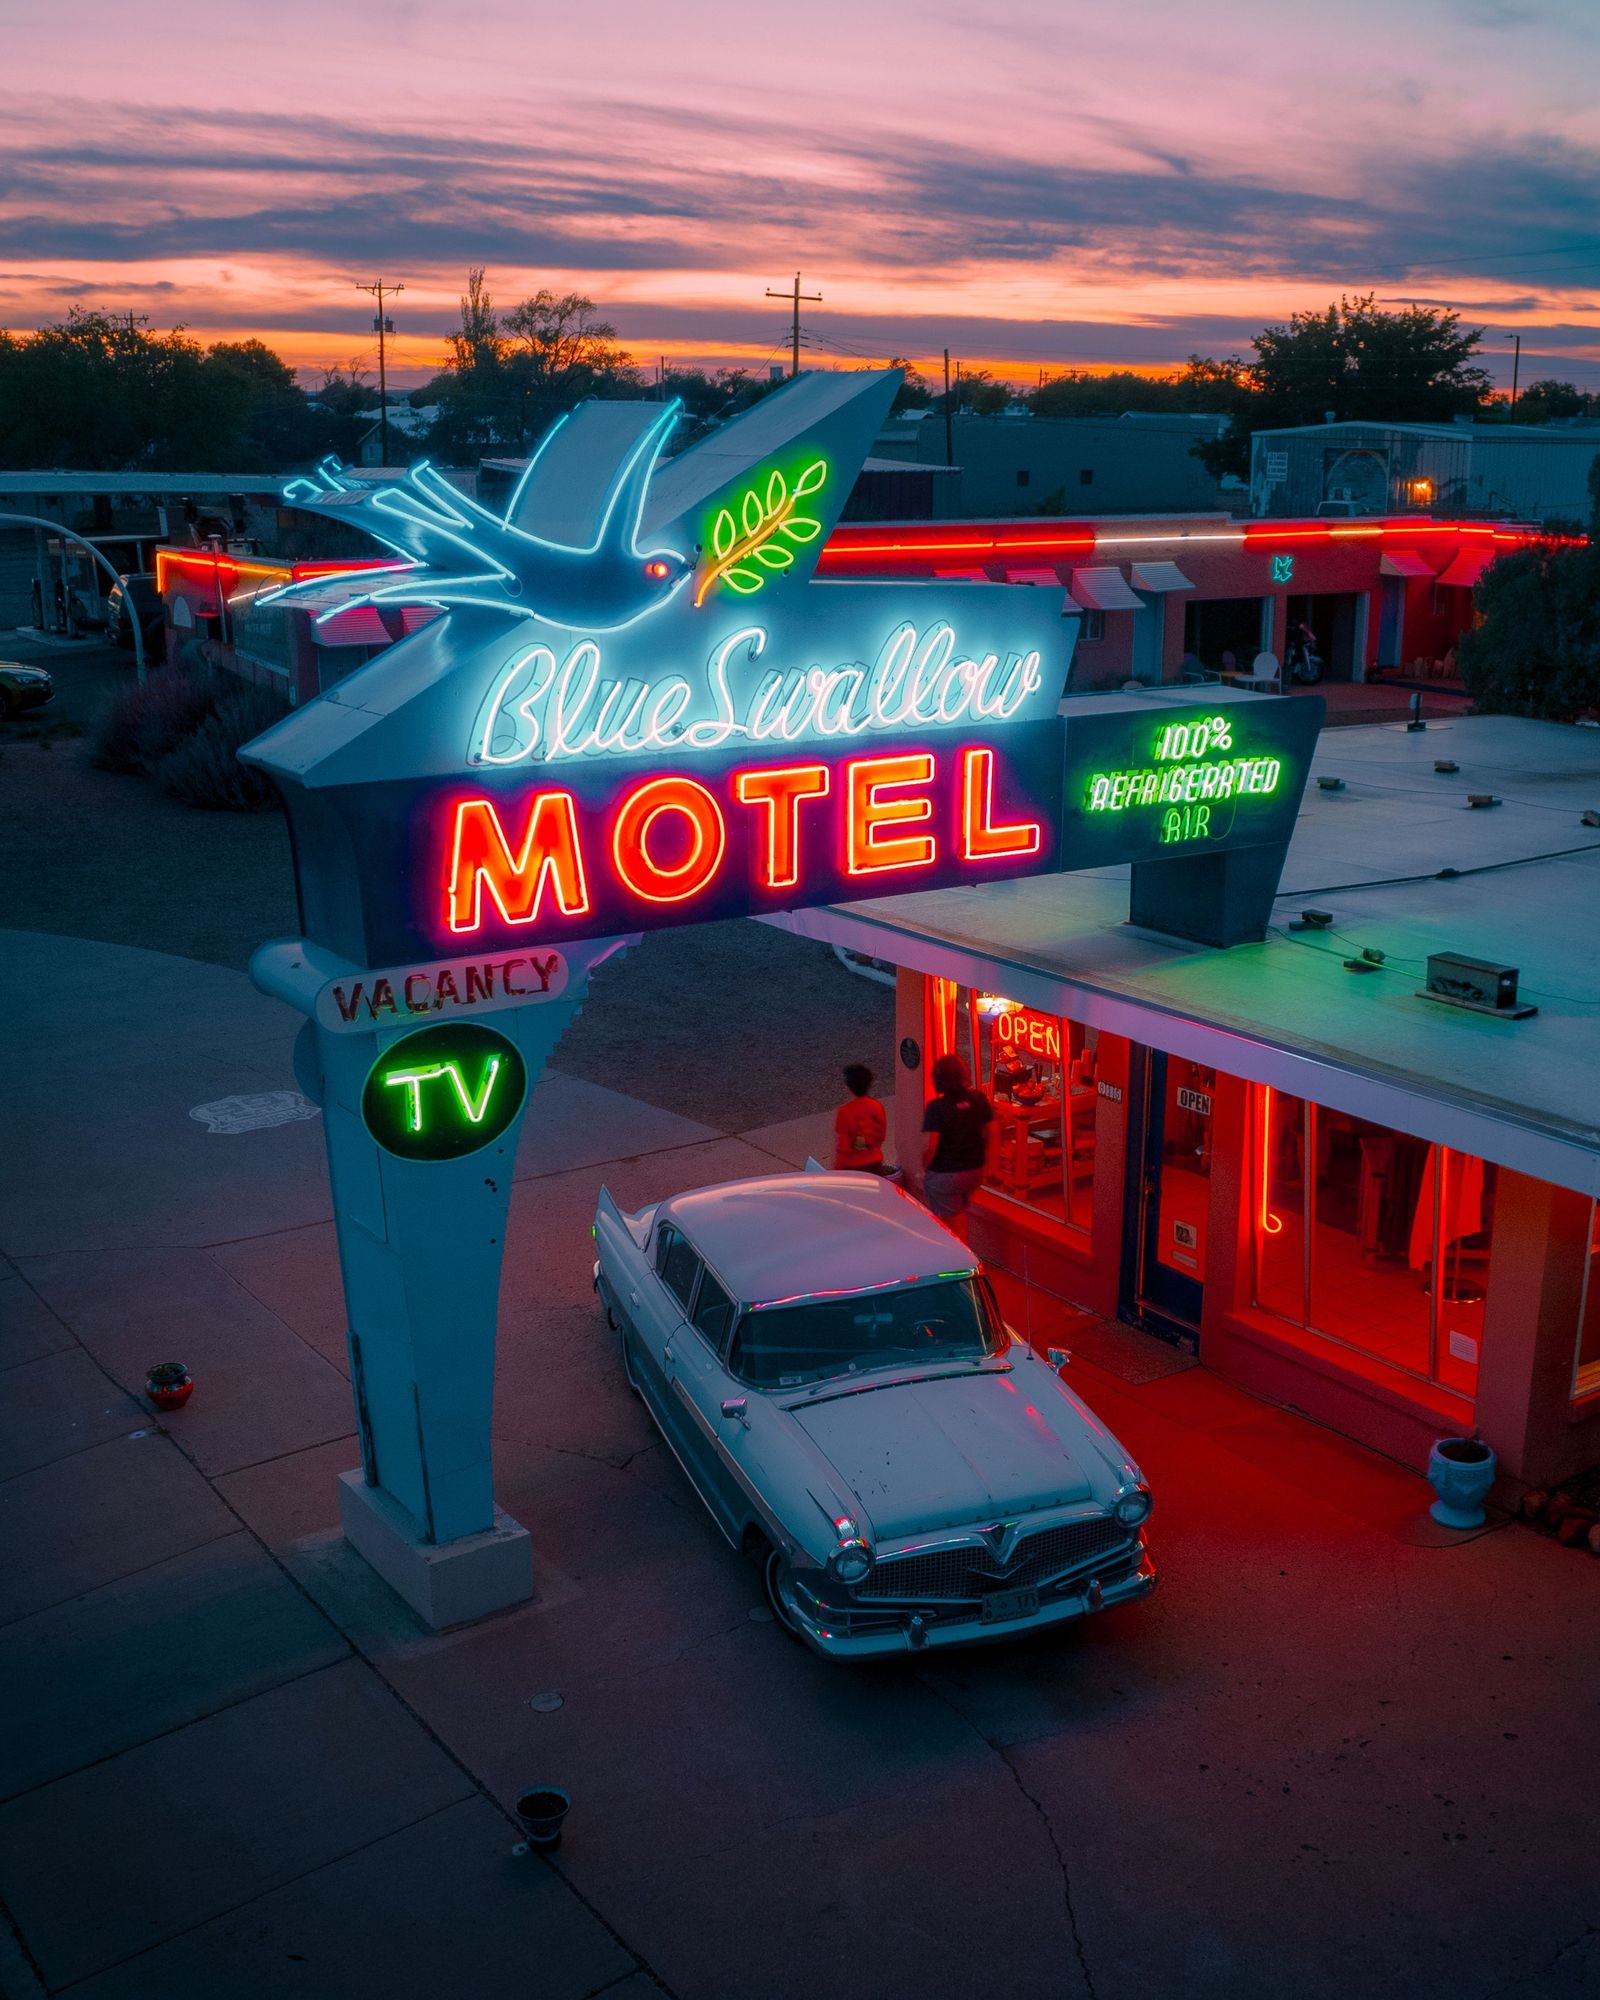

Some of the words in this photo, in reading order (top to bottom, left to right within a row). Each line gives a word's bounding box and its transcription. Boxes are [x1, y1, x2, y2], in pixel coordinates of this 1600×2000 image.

[466, 637, 691, 766] Blue
[688, 619, 1041, 748] Swallow
[1156, 716, 1233, 760] 100%
[1089, 758, 1281, 811] REFRIGERATED
[446, 749, 1041, 933] MOTEL
[1162, 806, 1211, 843] AIR
[332, 953, 558, 1022] VACANCY
[998, 1012, 1061, 1058] OPEN
[384, 1054, 501, 1131] TV
[1180, 1089, 1210, 1114] OPEN
